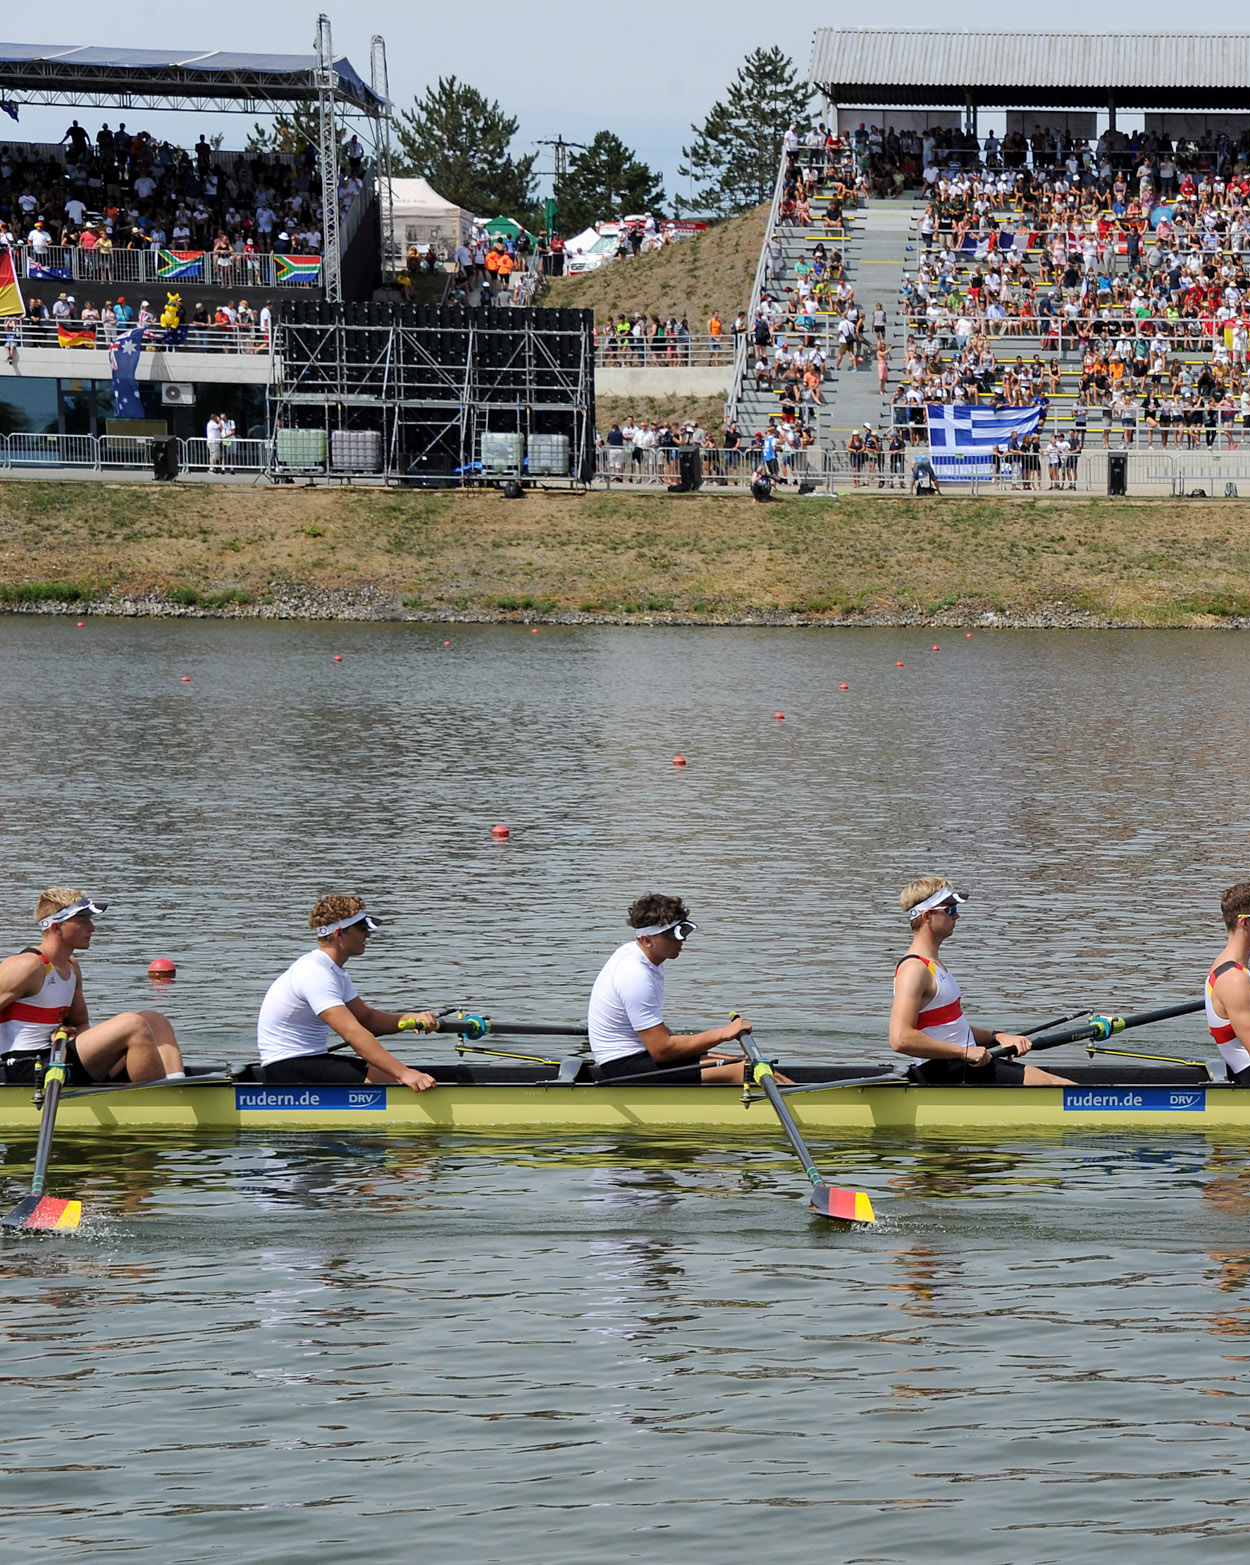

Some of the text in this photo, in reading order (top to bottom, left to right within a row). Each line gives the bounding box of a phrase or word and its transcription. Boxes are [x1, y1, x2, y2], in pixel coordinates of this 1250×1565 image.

[239, 1091, 320, 1106] rudern.de
[349, 1094, 374, 1103] DRV
[1067, 1092, 1142, 1106] rudern.de
[1170, 1095, 1194, 1104] DRV
